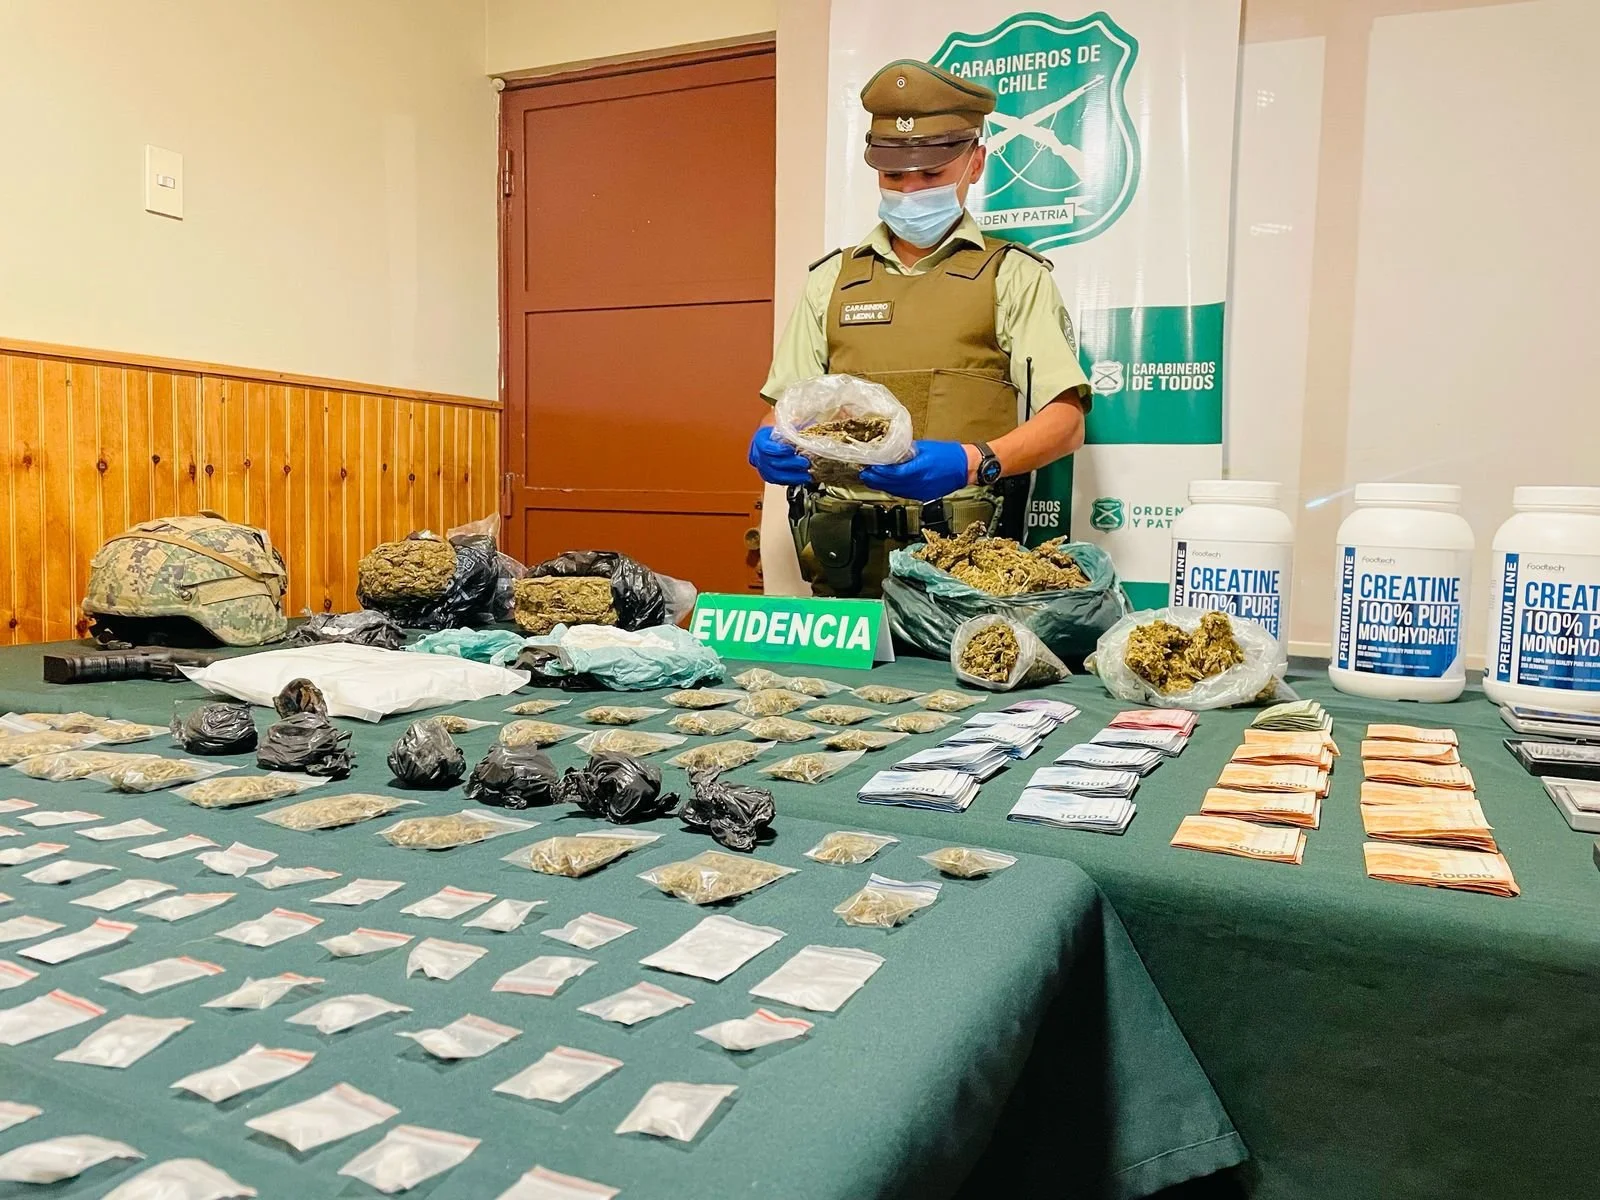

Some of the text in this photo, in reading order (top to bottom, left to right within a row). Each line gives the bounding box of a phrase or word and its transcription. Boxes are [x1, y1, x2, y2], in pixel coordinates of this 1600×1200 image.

[950, 44, 1101, 79] CARABINEROS DE
[998, 72, 1048, 95] CHILE
[975, 209, 1068, 226] RDEN Y PATRIA
[845, 303, 888, 312] CARABINERO
[1132, 361, 1216, 375] CARABINEROS
[1132, 374, 1214, 391] DE TODOS
[1028, 513, 1059, 527] DOS
[1132, 518, 1173, 528] Y PAT
[1133, 506, 1184, 516] ORDEN
[1177, 549, 1186, 580] LINE
[1190, 567, 1280, 594] CREATINE
[1360, 573, 1460, 602] CREATINE
[1191, 592, 1237, 615] 100%
[1241, 595, 1279, 617] PURE
[1340, 555, 1354, 661] PREMIUM LINE
[1525, 581, 1600, 611] CREAT
[1360, 601, 1413, 626] 100%
[1418, 605, 1458, 627] PURE
[1499, 562, 1517, 674] PREMIUM LINE
[1525, 610, 1583, 637] 100%
[693, 608, 871, 651] EVIDENCIA
[1358, 623, 1457, 645] MONOHYDRATE
[1522, 634, 1600, 657] MONOHYD
